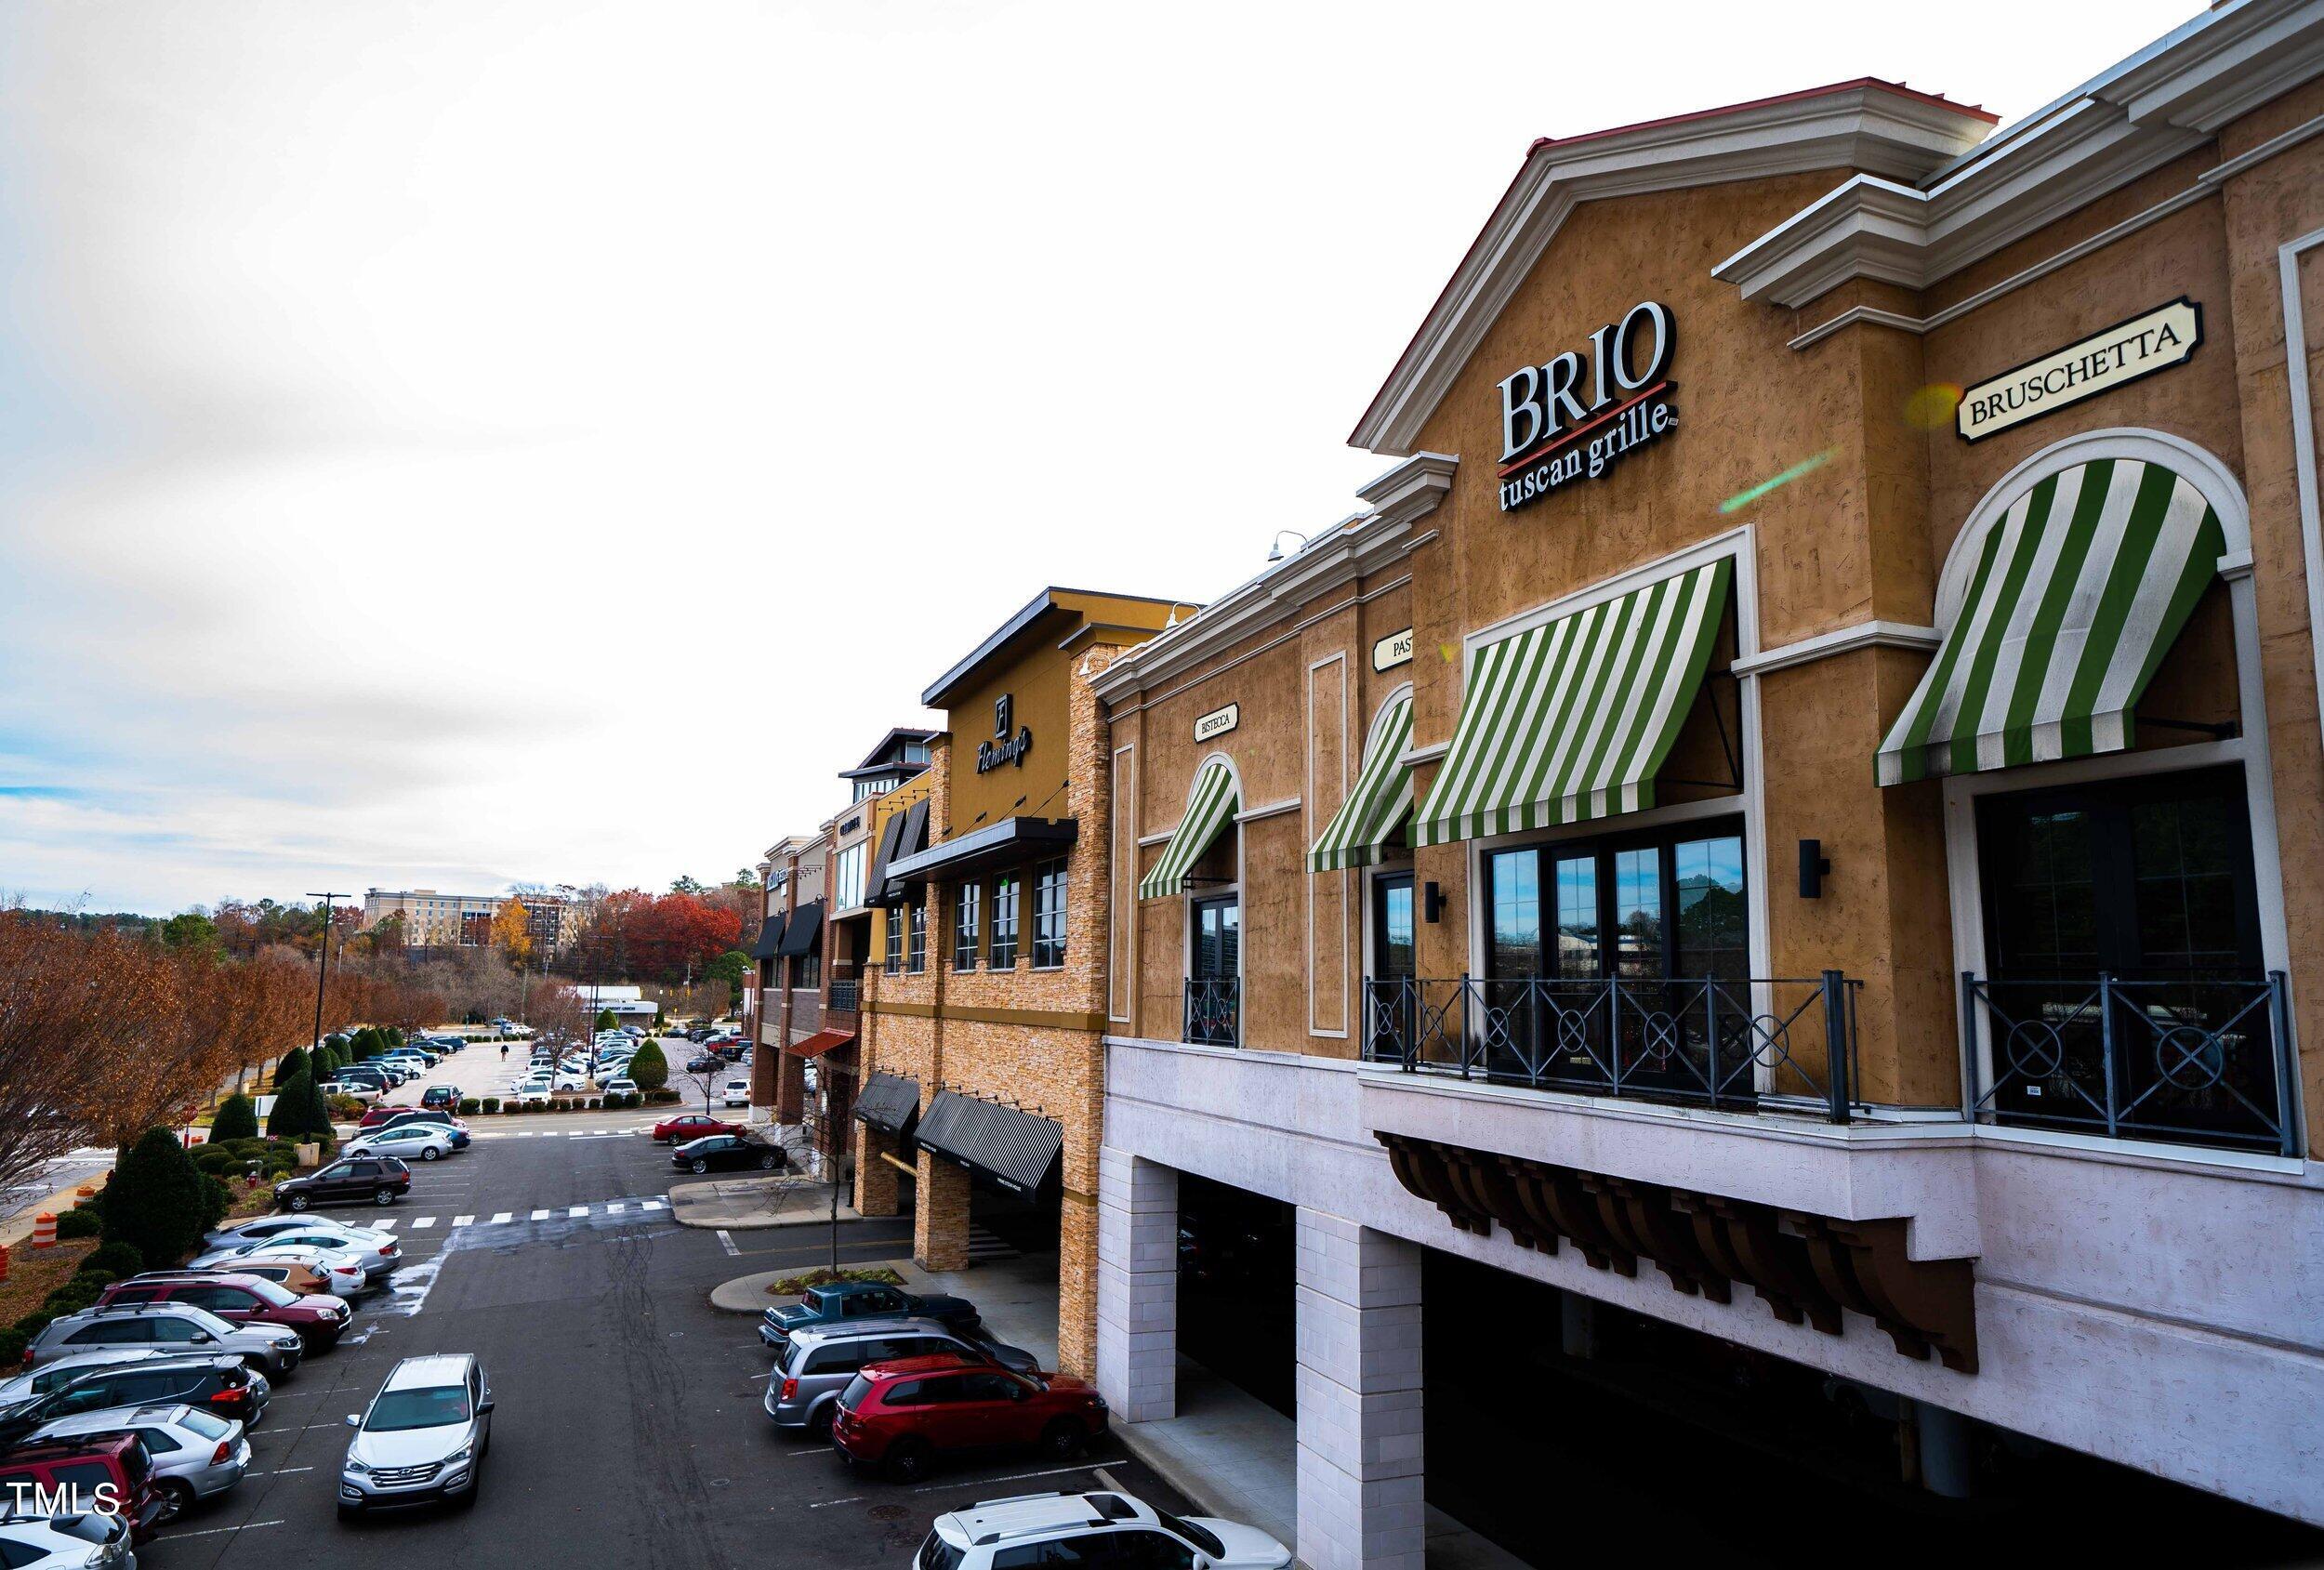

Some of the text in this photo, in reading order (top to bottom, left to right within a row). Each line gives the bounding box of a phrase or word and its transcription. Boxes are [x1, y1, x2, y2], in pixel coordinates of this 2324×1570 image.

[1496, 300, 1670, 463] BRIO
[1969, 322, 2182, 427] BRUSCHETTA
[1498, 399, 1670, 512] tuscan grille
[1393, 636, 1413, 657] PAS
[1201, 712, 1230, 734] BISTECCA
